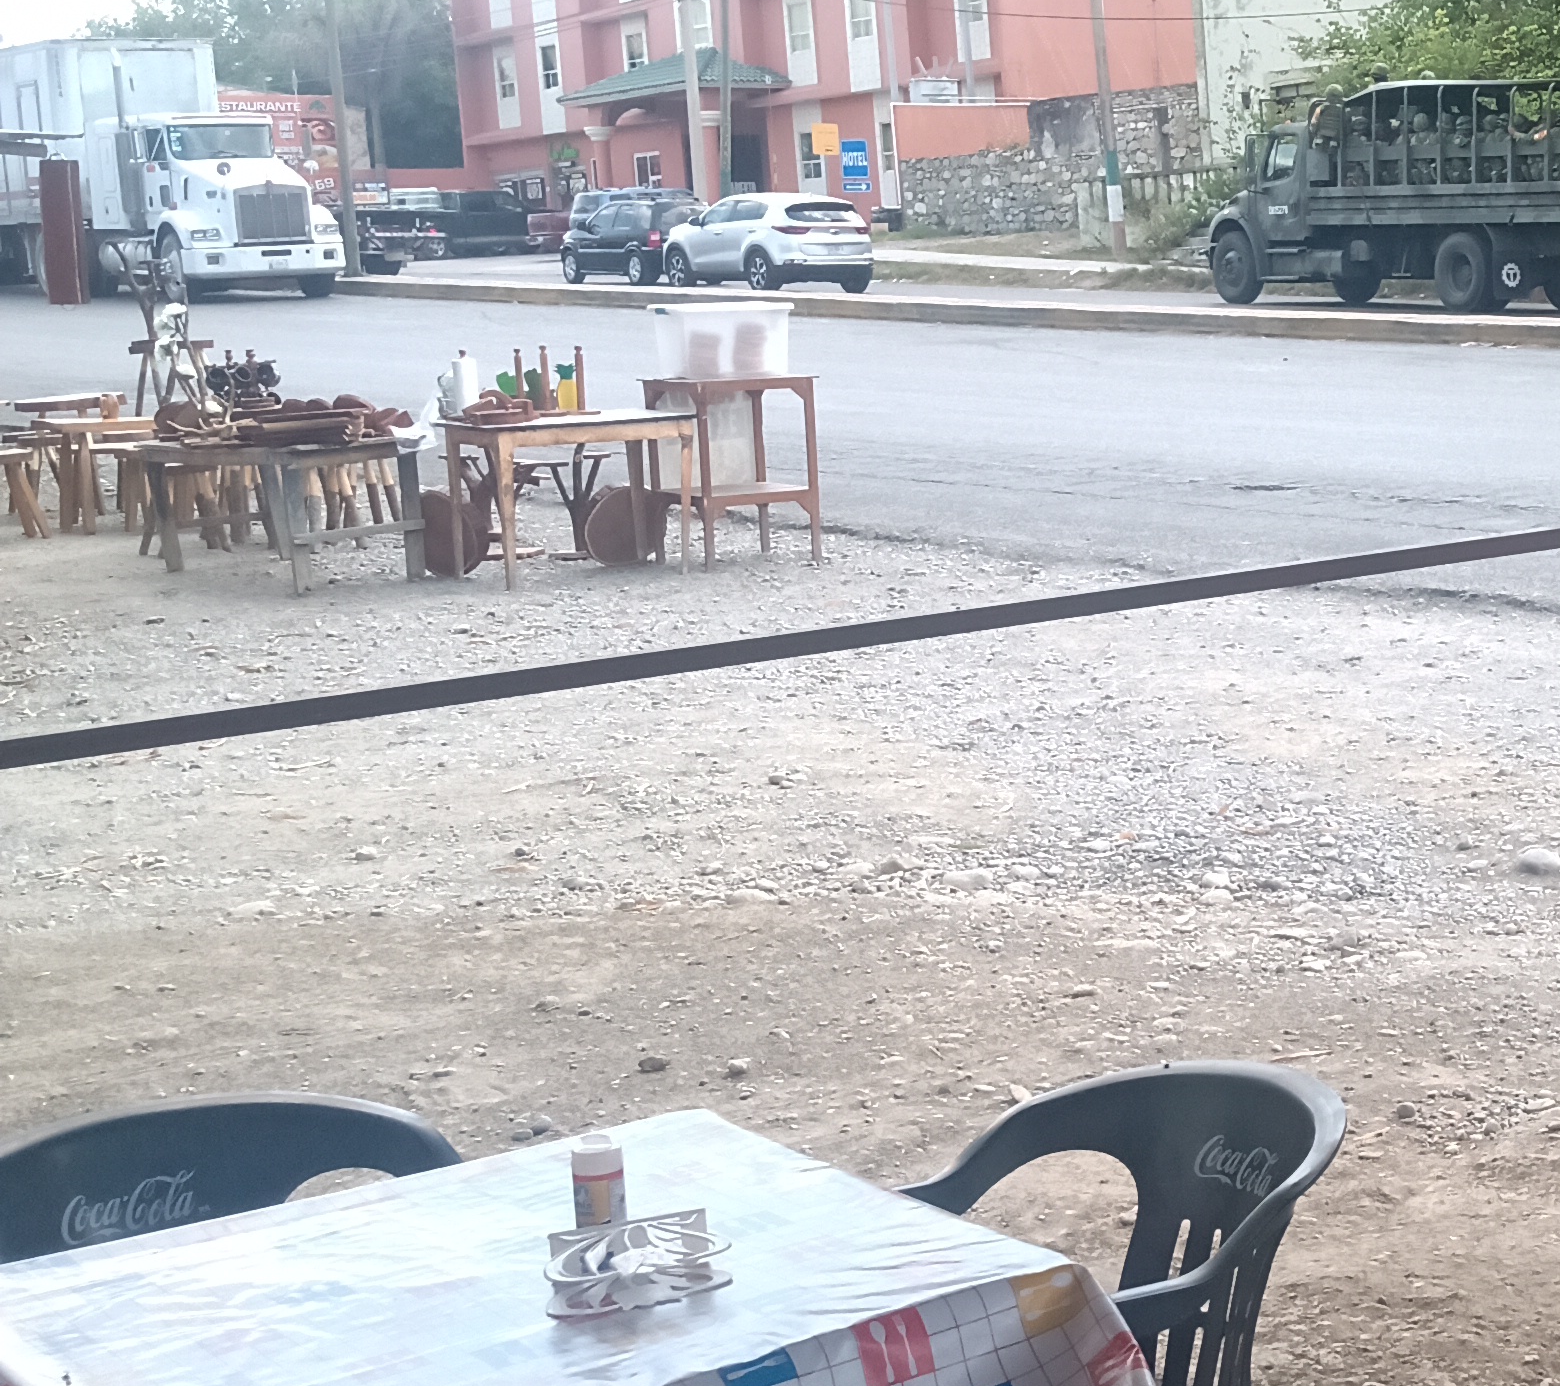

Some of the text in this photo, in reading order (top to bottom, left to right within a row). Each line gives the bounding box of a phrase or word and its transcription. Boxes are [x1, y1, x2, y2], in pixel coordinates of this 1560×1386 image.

[842, 151, 867, 167] HOTEL
[1194, 1134, 1279, 1197] Coca-Cola
[61, 1168, 196, 1245] Coca-Cola
